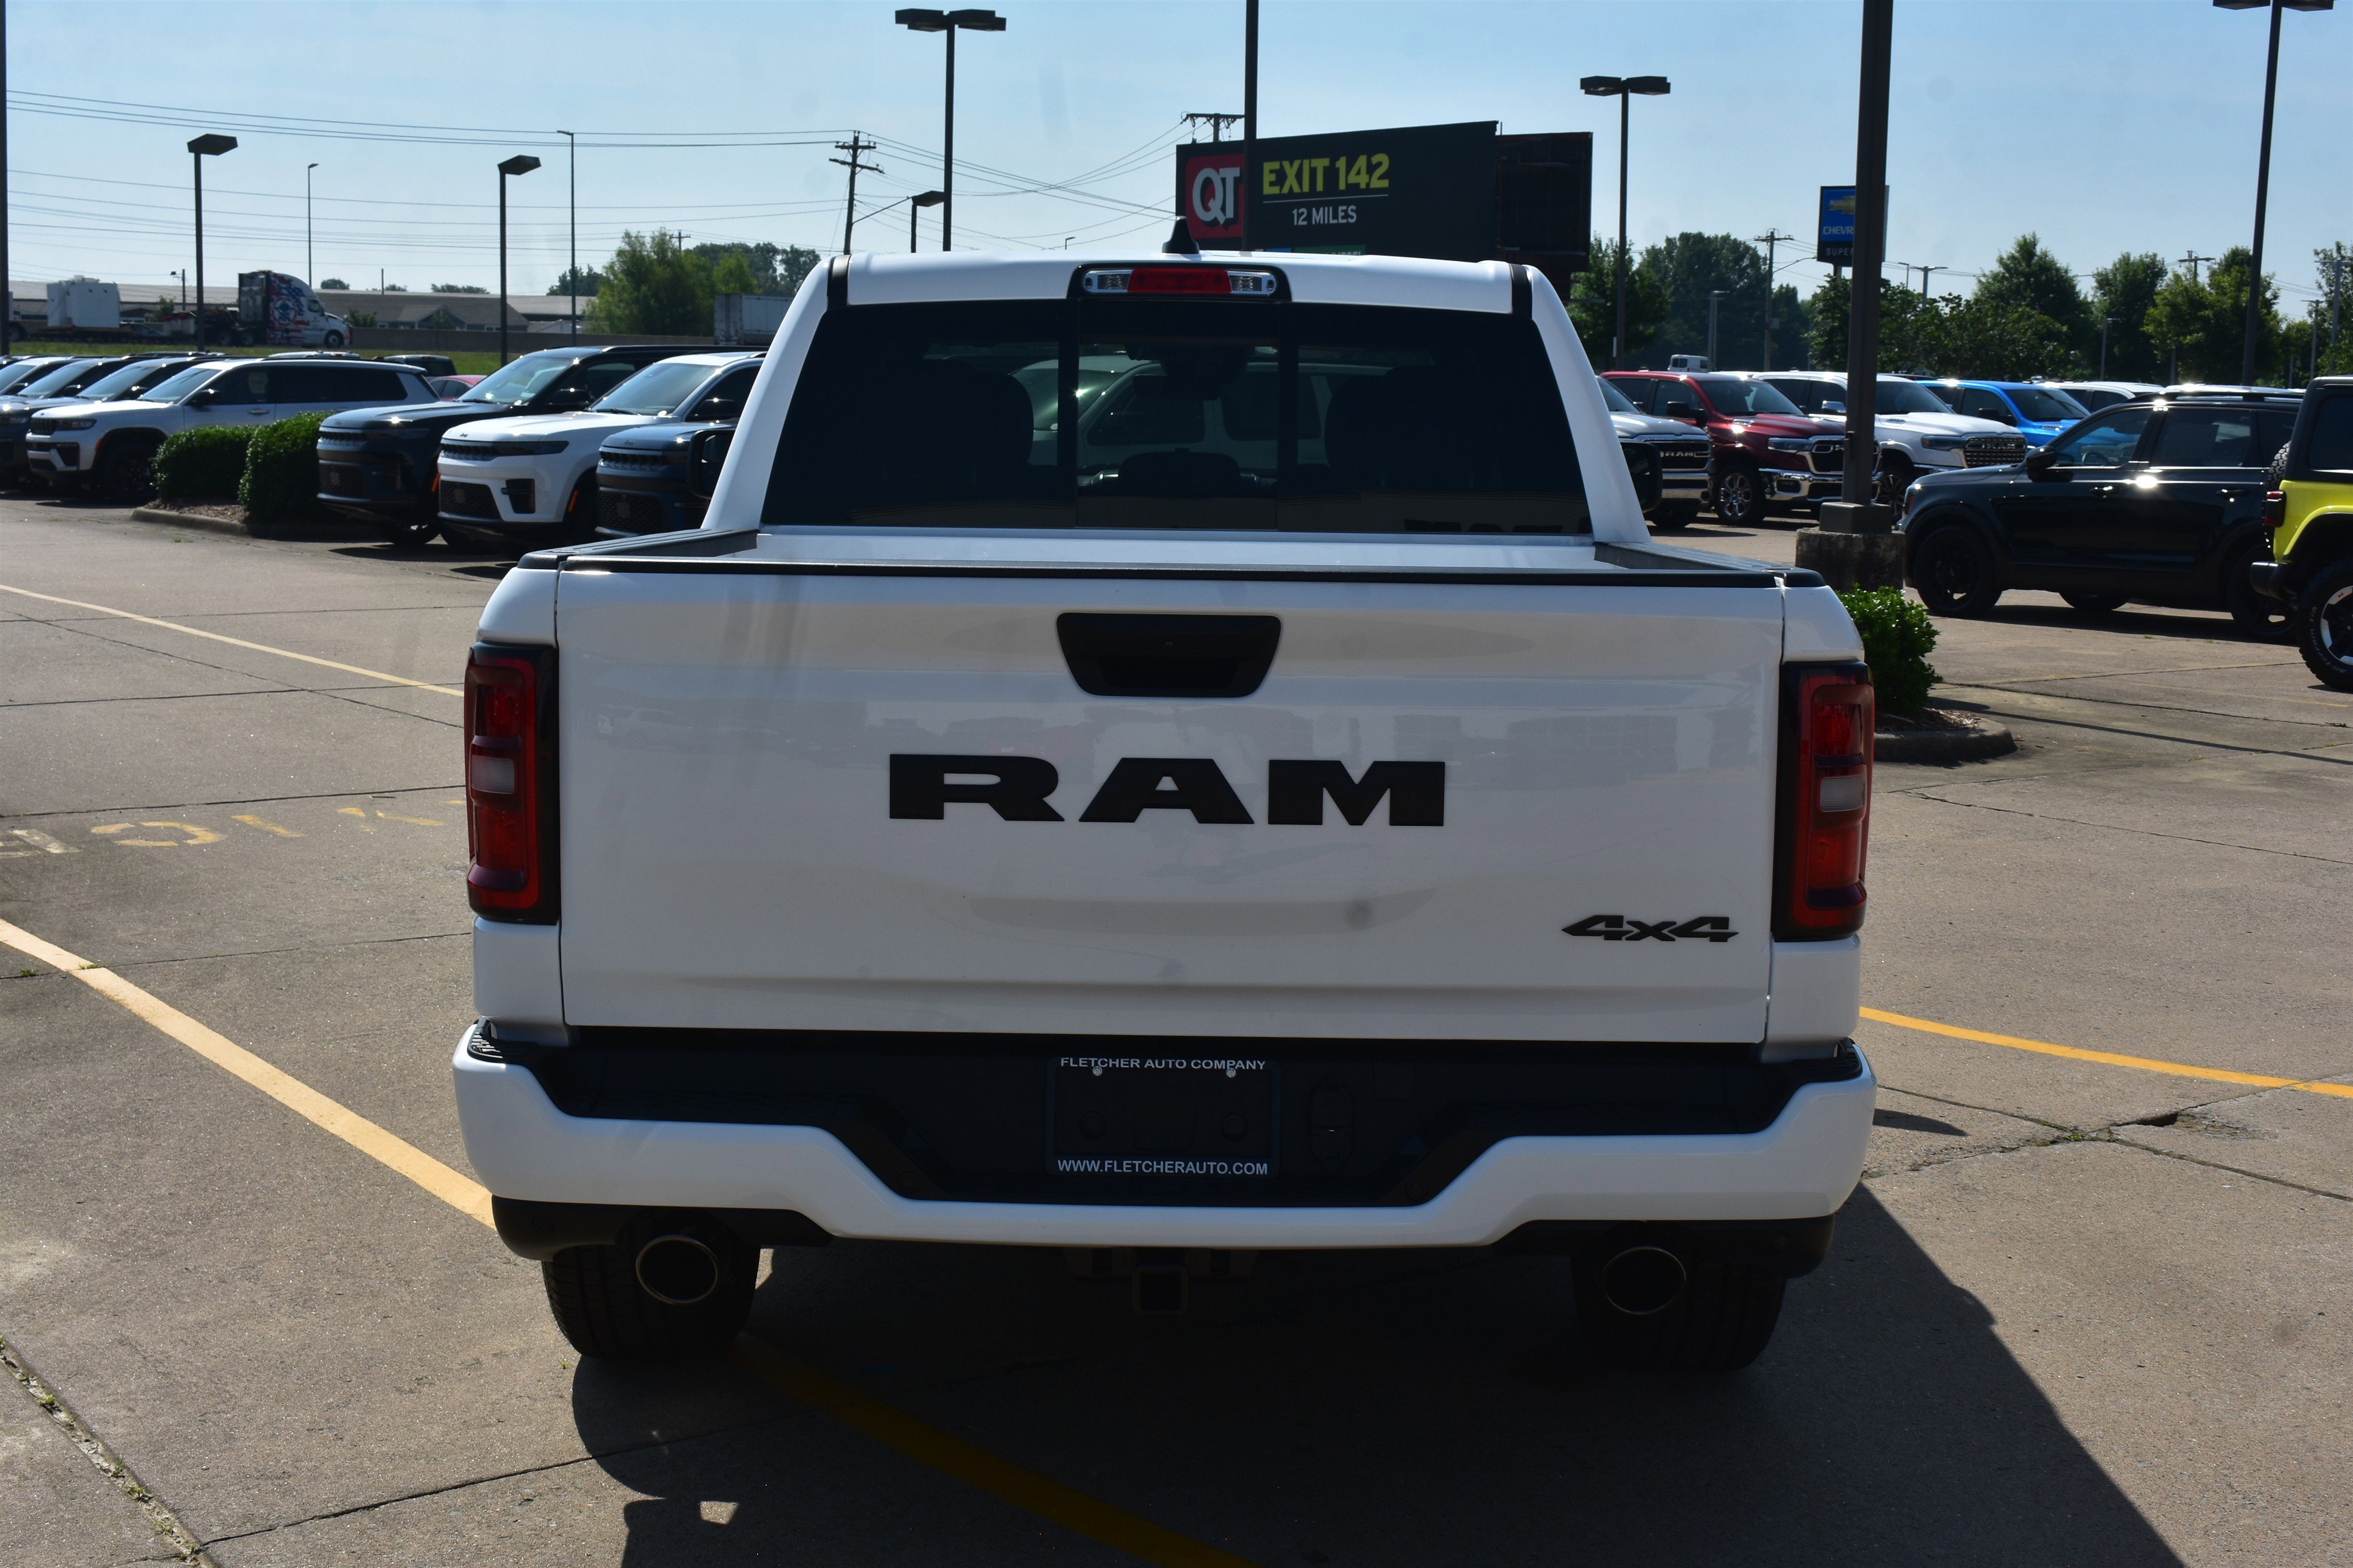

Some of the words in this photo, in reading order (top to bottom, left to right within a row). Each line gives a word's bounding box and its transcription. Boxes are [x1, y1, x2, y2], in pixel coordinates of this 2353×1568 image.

[1263, 157, 1330, 195] EXIT
[1335, 153, 1390, 191] 142
[1192, 167, 1240, 225] QT
[1292, 207, 1308, 226] 12
[1312, 205, 1357, 224] MILES
[889, 753, 1445, 827] RAM
[1561, 915, 1739, 943] 4x4
[1060, 1057, 1140, 1069] FLETCHER
[1144, 1058, 1186, 1069] AUTO
[1191, 1059, 1266, 1071] COMPANY
[1058, 1159, 1268, 1175] WWW.FLETCHERAUTO.COM
